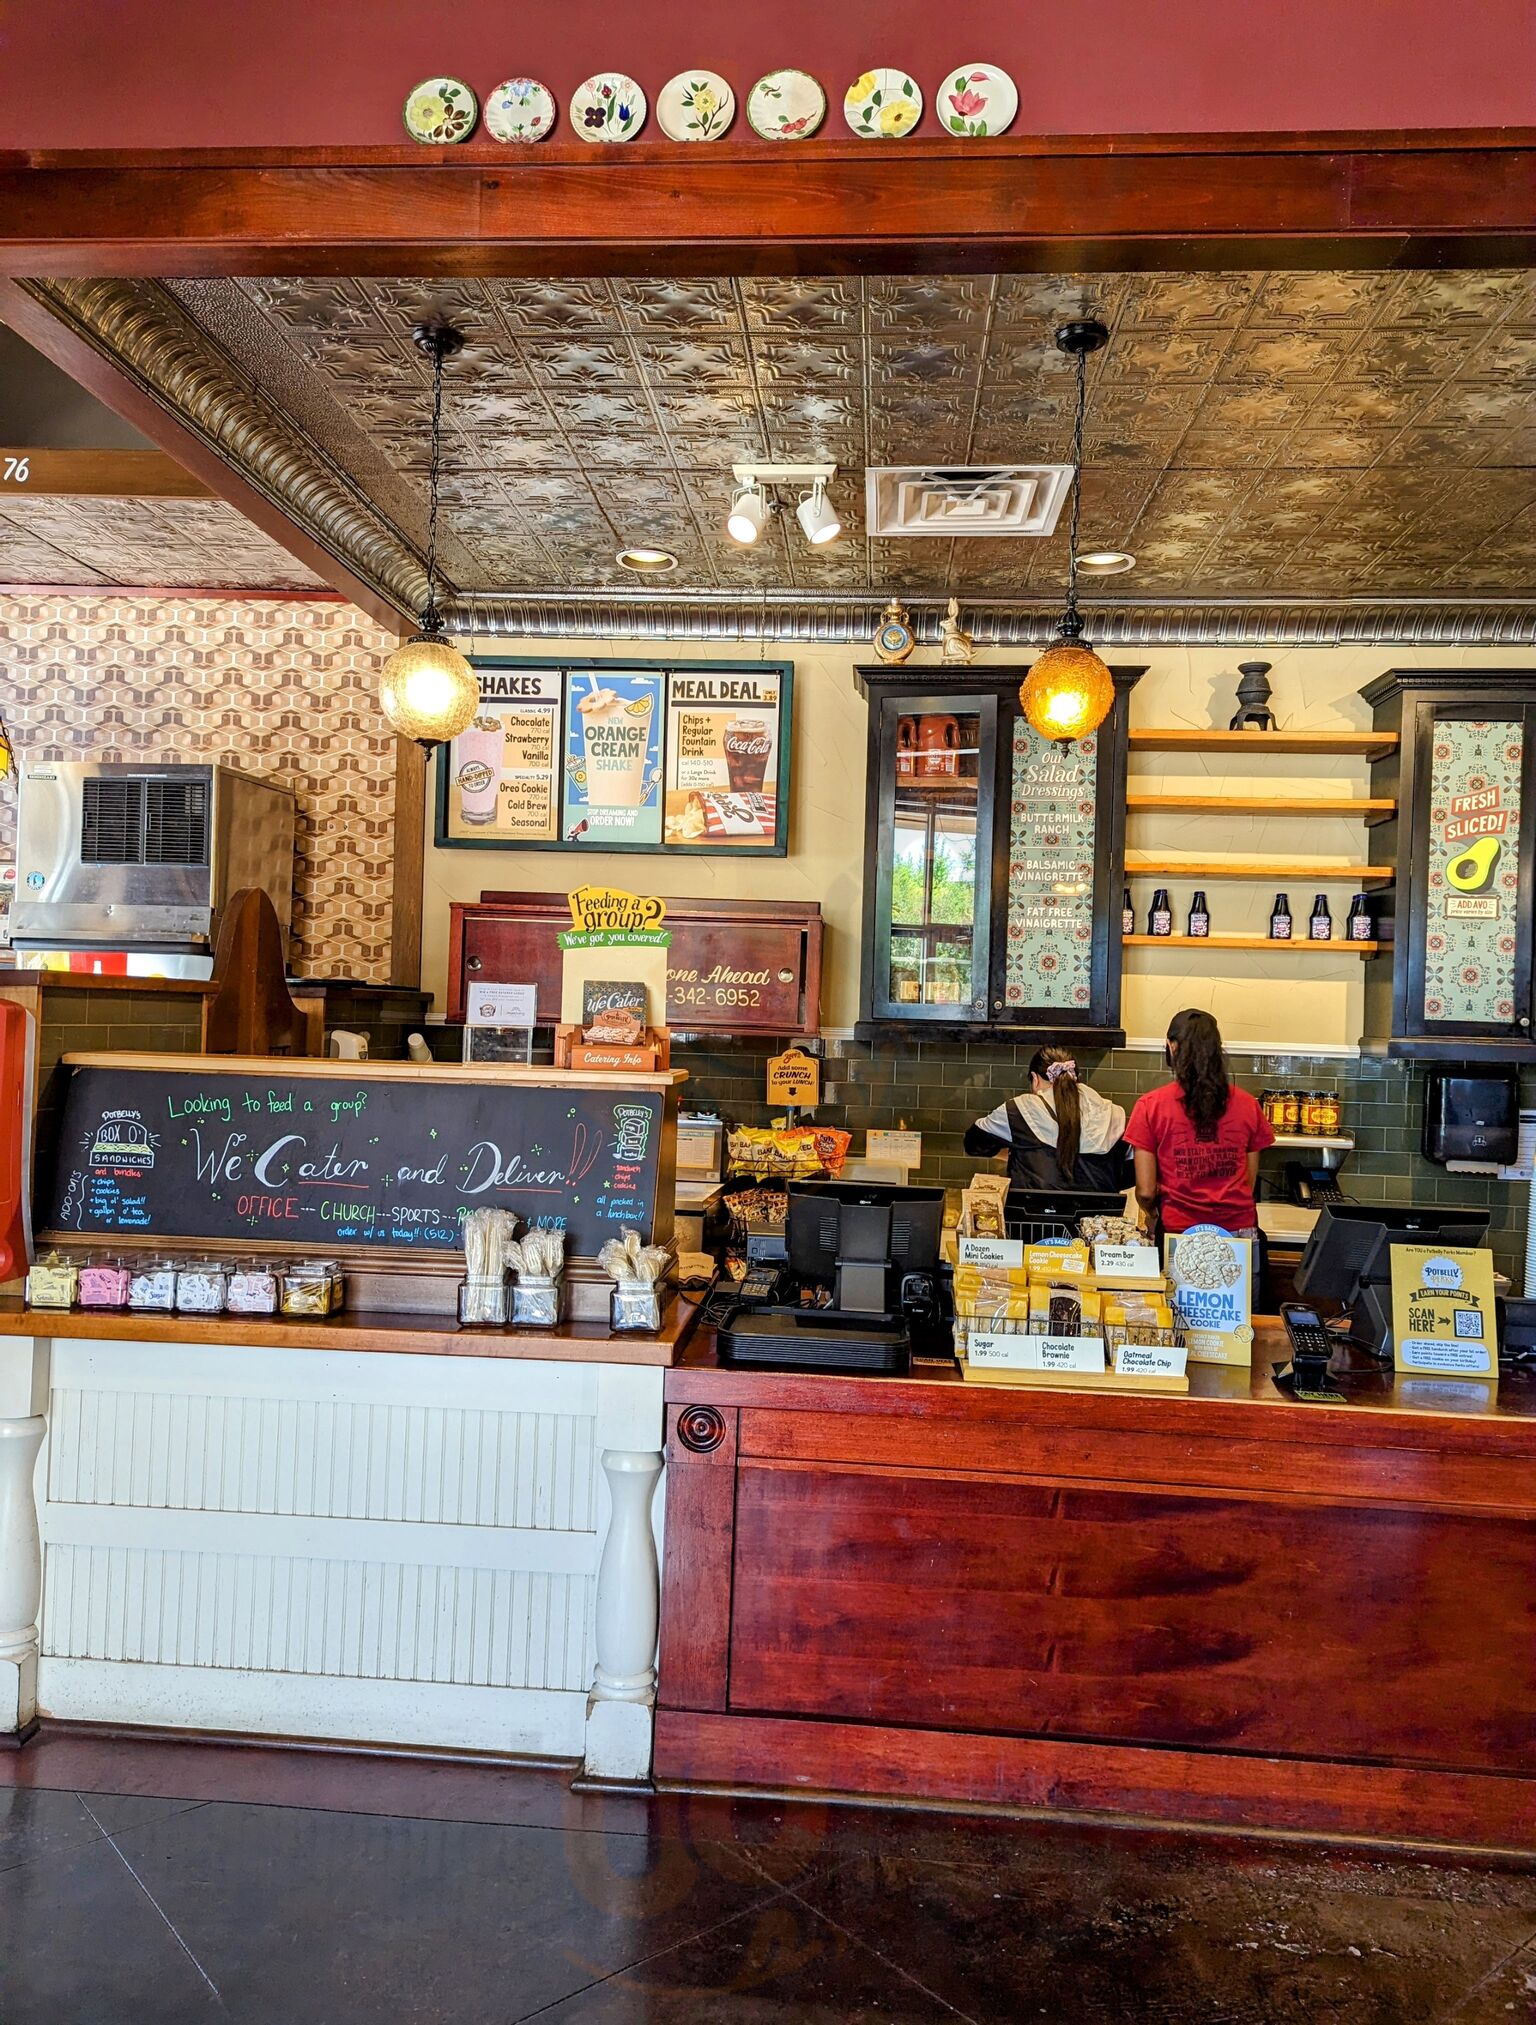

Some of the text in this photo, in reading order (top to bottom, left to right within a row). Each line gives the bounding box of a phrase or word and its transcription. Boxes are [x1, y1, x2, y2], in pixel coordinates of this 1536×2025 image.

[3, 457, 30, 482] 76
[672, 681, 761, 700] MEAL DEAL
[511, 716, 550, 727] Chocolate
[683, 715, 704, 726] Chips
[585, 726, 647, 742] ORANGE
[683, 726, 713, 737] Regular
[505, 733, 550, 746] Strawberry
[682, 736, 716, 746] Fountain
[522, 750, 549, 760] Vanilla
[591, 742, 640, 758] CREAM
[682, 747, 704, 757] Drink
[1042, 752, 1063, 764] Our
[596, 759, 633, 771] SHAKE
[1027, 765, 1079, 783] Salad
[500, 782, 548, 793] Oreo Cookie
[1021, 785, 1085, 801] Dressings
[508, 799, 547, 810] Cold Brew
[1455, 789, 1496, 812] FRESH
[511, 817, 547, 827] Seasonal
[590, 816, 635, 826] ORDER NOW!
[1021, 813, 1084, 824] BUTTERMILK
[1034, 825, 1070, 834] RANCH
[1447, 813, 1505, 839] SLICED!
[1027, 860, 1076, 870] BALSAMIC
[1017, 872, 1084, 882] VINAIGRETTE
[572, 888, 640, 916] Feeding a
[1457, 900, 1488, 909] ADD AVO
[584, 899, 661, 933] group?
[1027, 907, 1073, 917] FAT FREE
[1016, 919, 1083, 928] VINAIGRETTE
[564, 932, 668, 946] We've got you covered!
[701, 965, 770, 985] Ahead
[587, 991, 644, 1012] We Cater
[584, 1052, 642, 1067] Catering Info
[773, 1071, 811, 1079] CRUNCH
[167, 1091, 367, 1122] Looking to feed a group?
[101, 1125, 120, 1142] BOX
[95, 1154, 152, 1164] SANDWICHES
[190, 1128, 247, 1184] We
[254, 1135, 369, 1188] Cater
[397, 1153, 449, 1186] and
[95, 1167, 107, 1176] and
[597, 1195, 606, 1204] all
[94, 1206, 115, 1217] gallon
[132, 1207, 144, 1215] tea
[237, 1195, 299, 1218] OFFICE
[320, 1201, 376, 1224] CHURCH
[391, 1206, 440, 1225] SPORTS
[536, 1216, 567, 1231] MORE
[337, 1227, 356, 1237] order
[363, 1227, 374, 1237] w/
[971, 1244, 990, 1252] Dozen
[965, 1251, 1004, 1260] Mini Cookies
[1029, 1250, 1083, 1259] Lemon Cheesecake
[1100, 1249, 1134, 1259] Dream Bar
[1425, 1267, 1459, 1278] POTBELLY
[1178, 1290, 1234, 1309] LEMON
[1420, 1289, 1435, 1297] EARN
[1449, 1290, 1469, 1300] POINTS
[1408, 1307, 1435, 1319] SCAN
[1190, 1319, 1221, 1329] COOKIE
[1409, 1319, 1435, 1333] HERE
[974, 1339, 994, 1349] Sugar
[1042, 1341, 1074, 1351] Chocolate
[1042, 1350, 1069, 1359] Brownie
[1124, 1351, 1153, 1359] Oatmeal
[1122, 1358, 1171, 1368] Chocolate Chip
